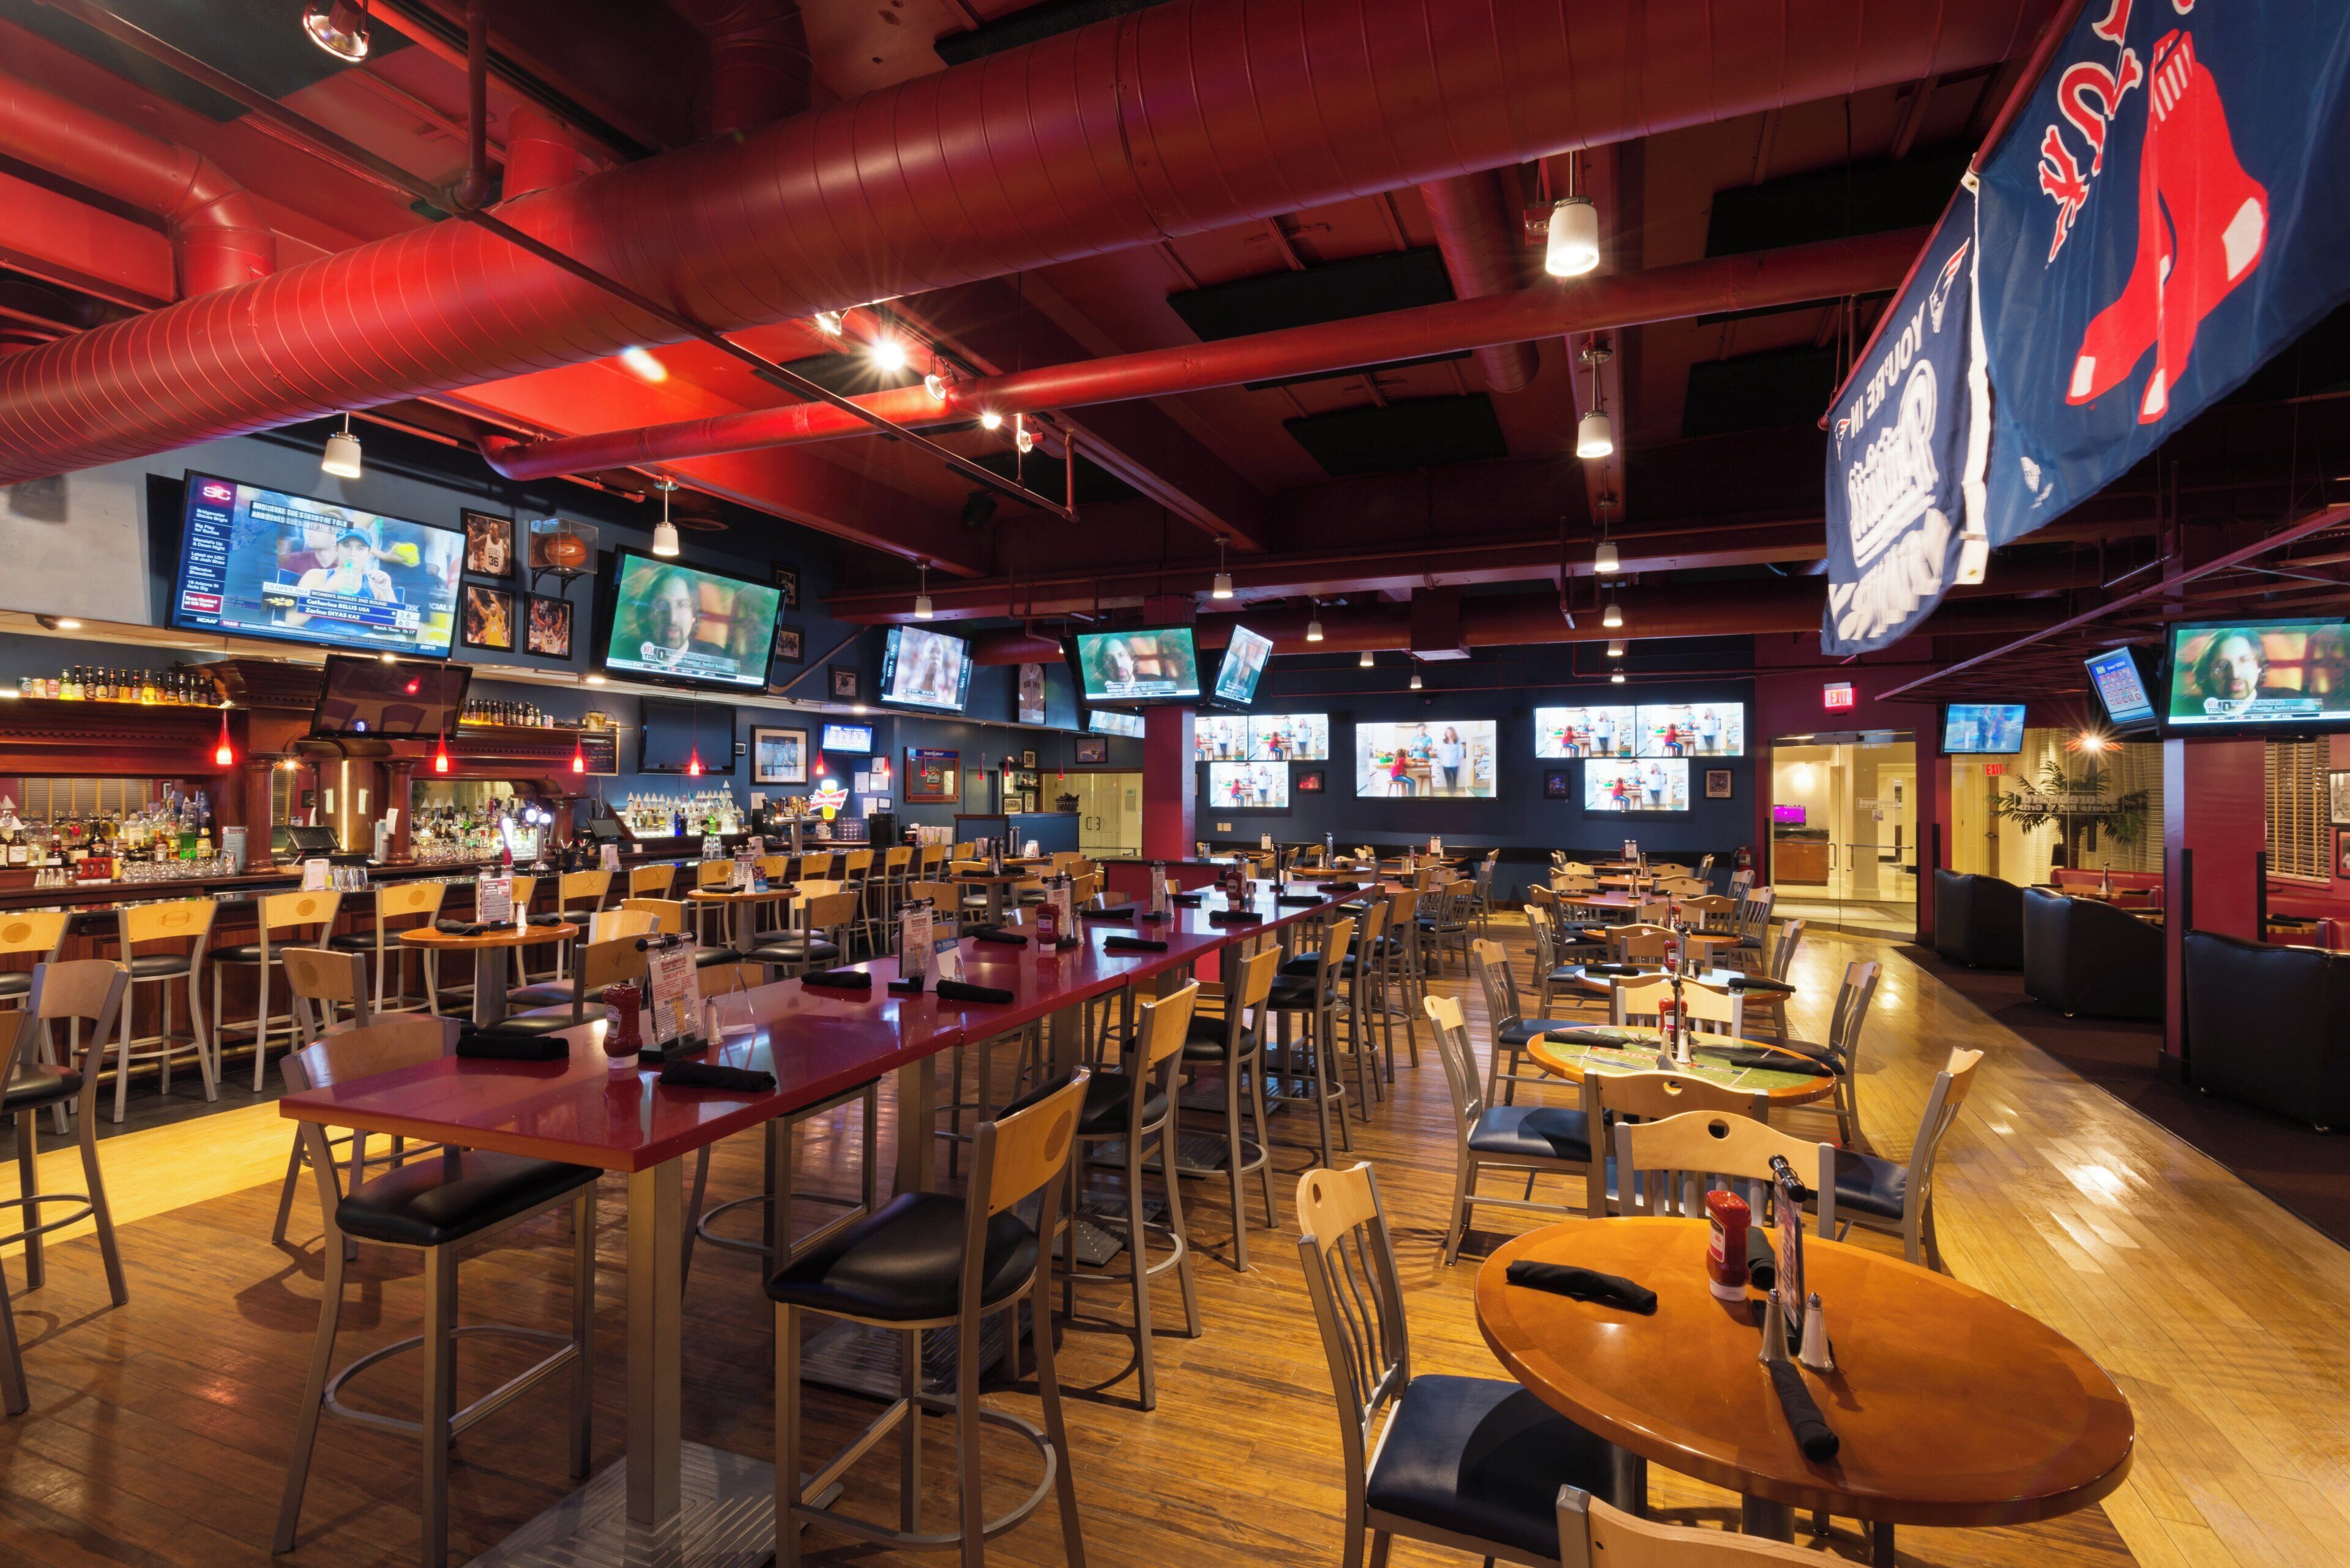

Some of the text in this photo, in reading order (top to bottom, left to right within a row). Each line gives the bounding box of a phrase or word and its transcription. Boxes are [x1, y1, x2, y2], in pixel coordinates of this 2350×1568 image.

[196, 508, 225, 518] Bridgewater
[489, 556, 498, 567] 36
[306, 598, 337, 608] Catherine
[643, 645, 653, 654] NFL
[1830, 690, 1848, 704] EXIT
[1986, 764, 2002, 775] EXIT
[663, 969, 686, 980] DRAFTS
[664, 993, 688, 1006] BOTTLES
